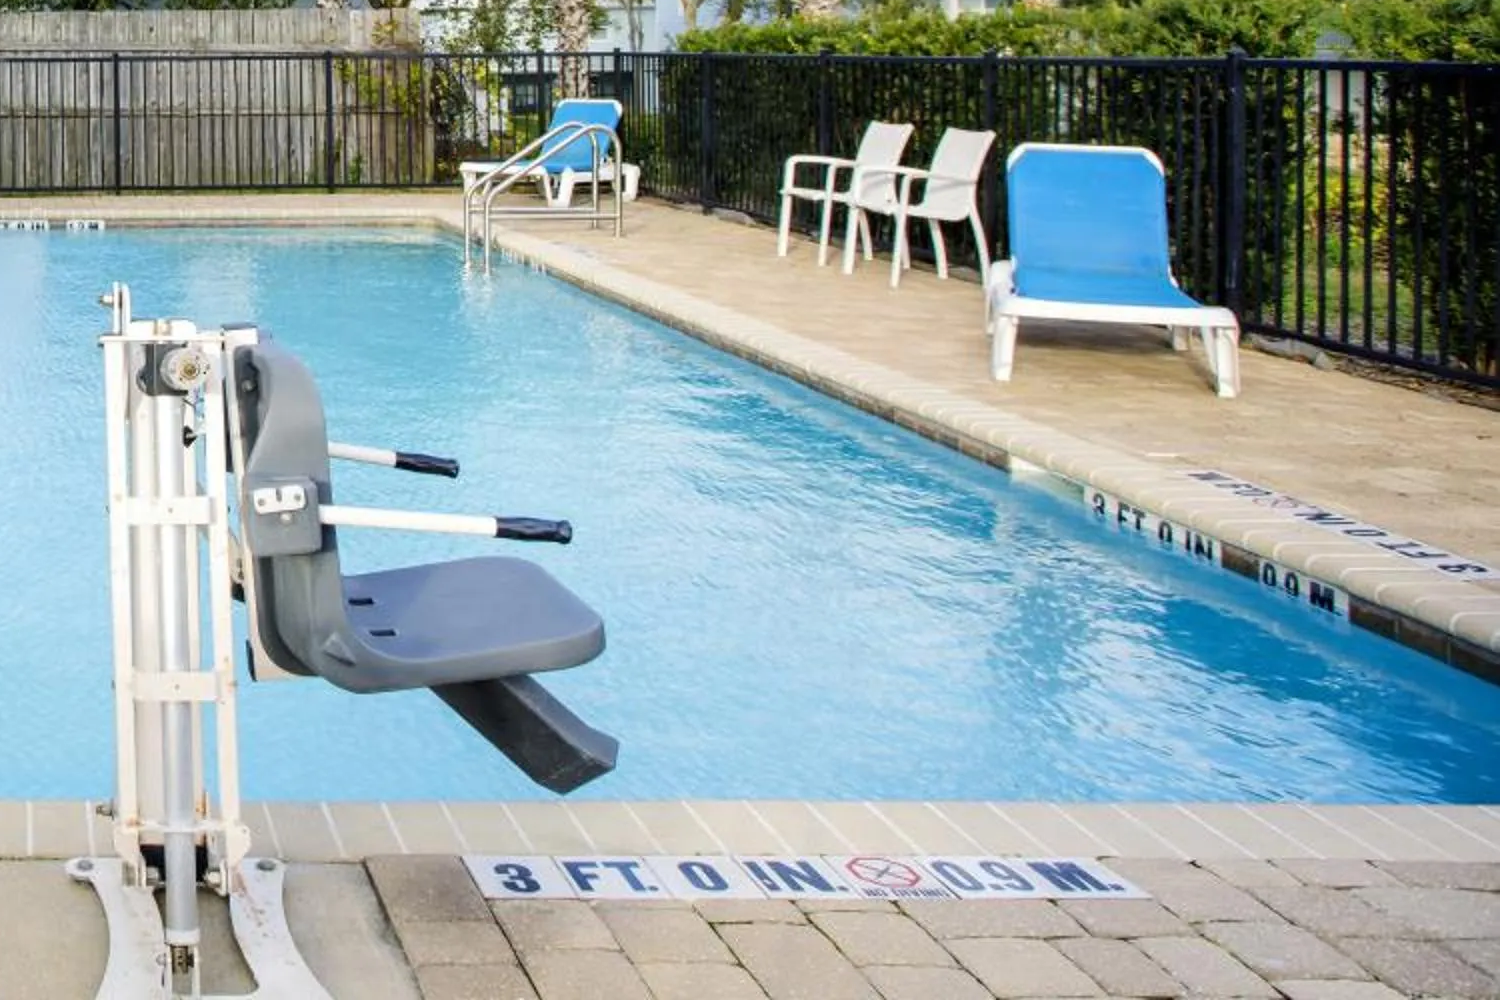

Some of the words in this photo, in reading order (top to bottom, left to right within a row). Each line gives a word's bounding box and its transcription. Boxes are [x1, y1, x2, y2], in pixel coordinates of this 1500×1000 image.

[493, 863, 542, 894] 3
[560, 860, 659, 893] FT.
[929, 859, 1036, 893] 0.9
